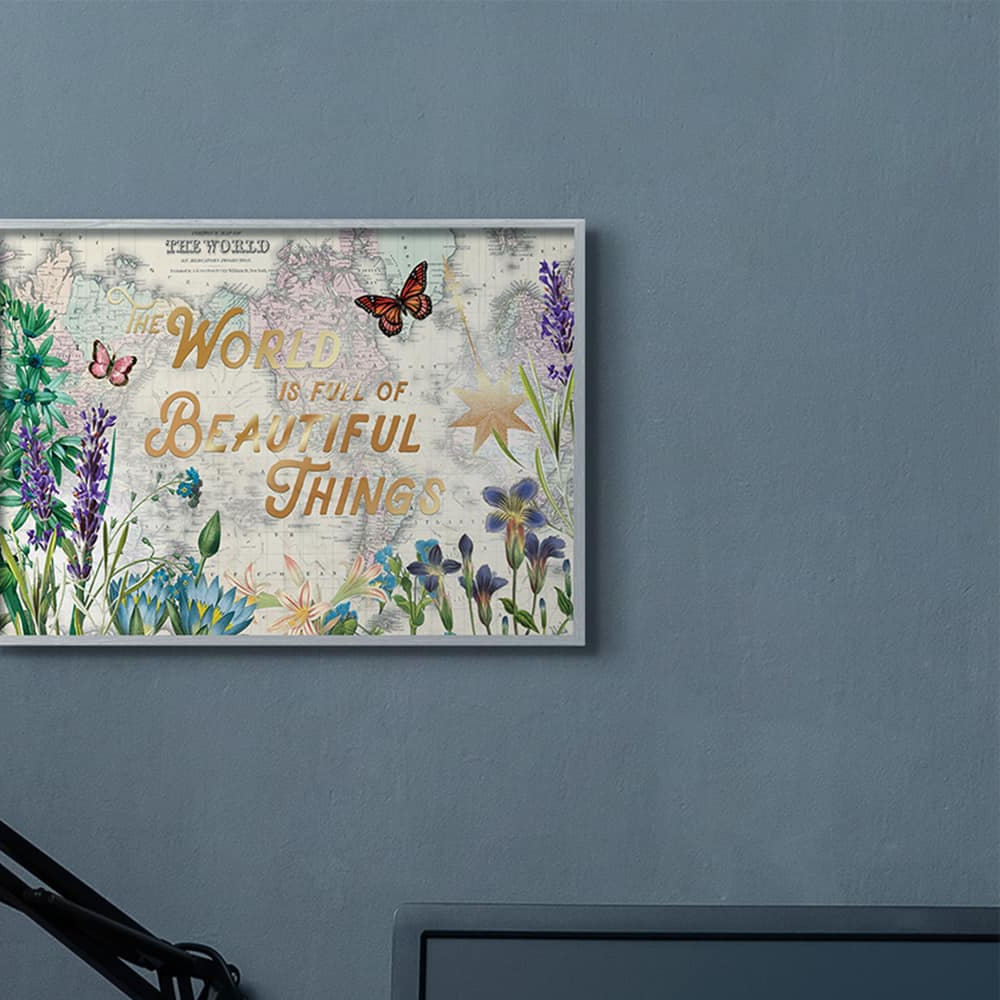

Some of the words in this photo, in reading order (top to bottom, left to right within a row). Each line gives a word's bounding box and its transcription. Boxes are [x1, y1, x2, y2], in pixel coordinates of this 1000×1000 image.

[165, 239, 201, 254] THE
[203, 239, 271, 254] WORLD
[107, 287, 165, 334] THE
[166, 306, 341, 369] WORLD
[278, 381, 299, 401] IS
[310, 381, 364, 401] FULL
[376, 381, 409, 401] OF
[144, 390, 421, 459] BEAUTIFUL
[265, 456, 446, 520] THINGS
